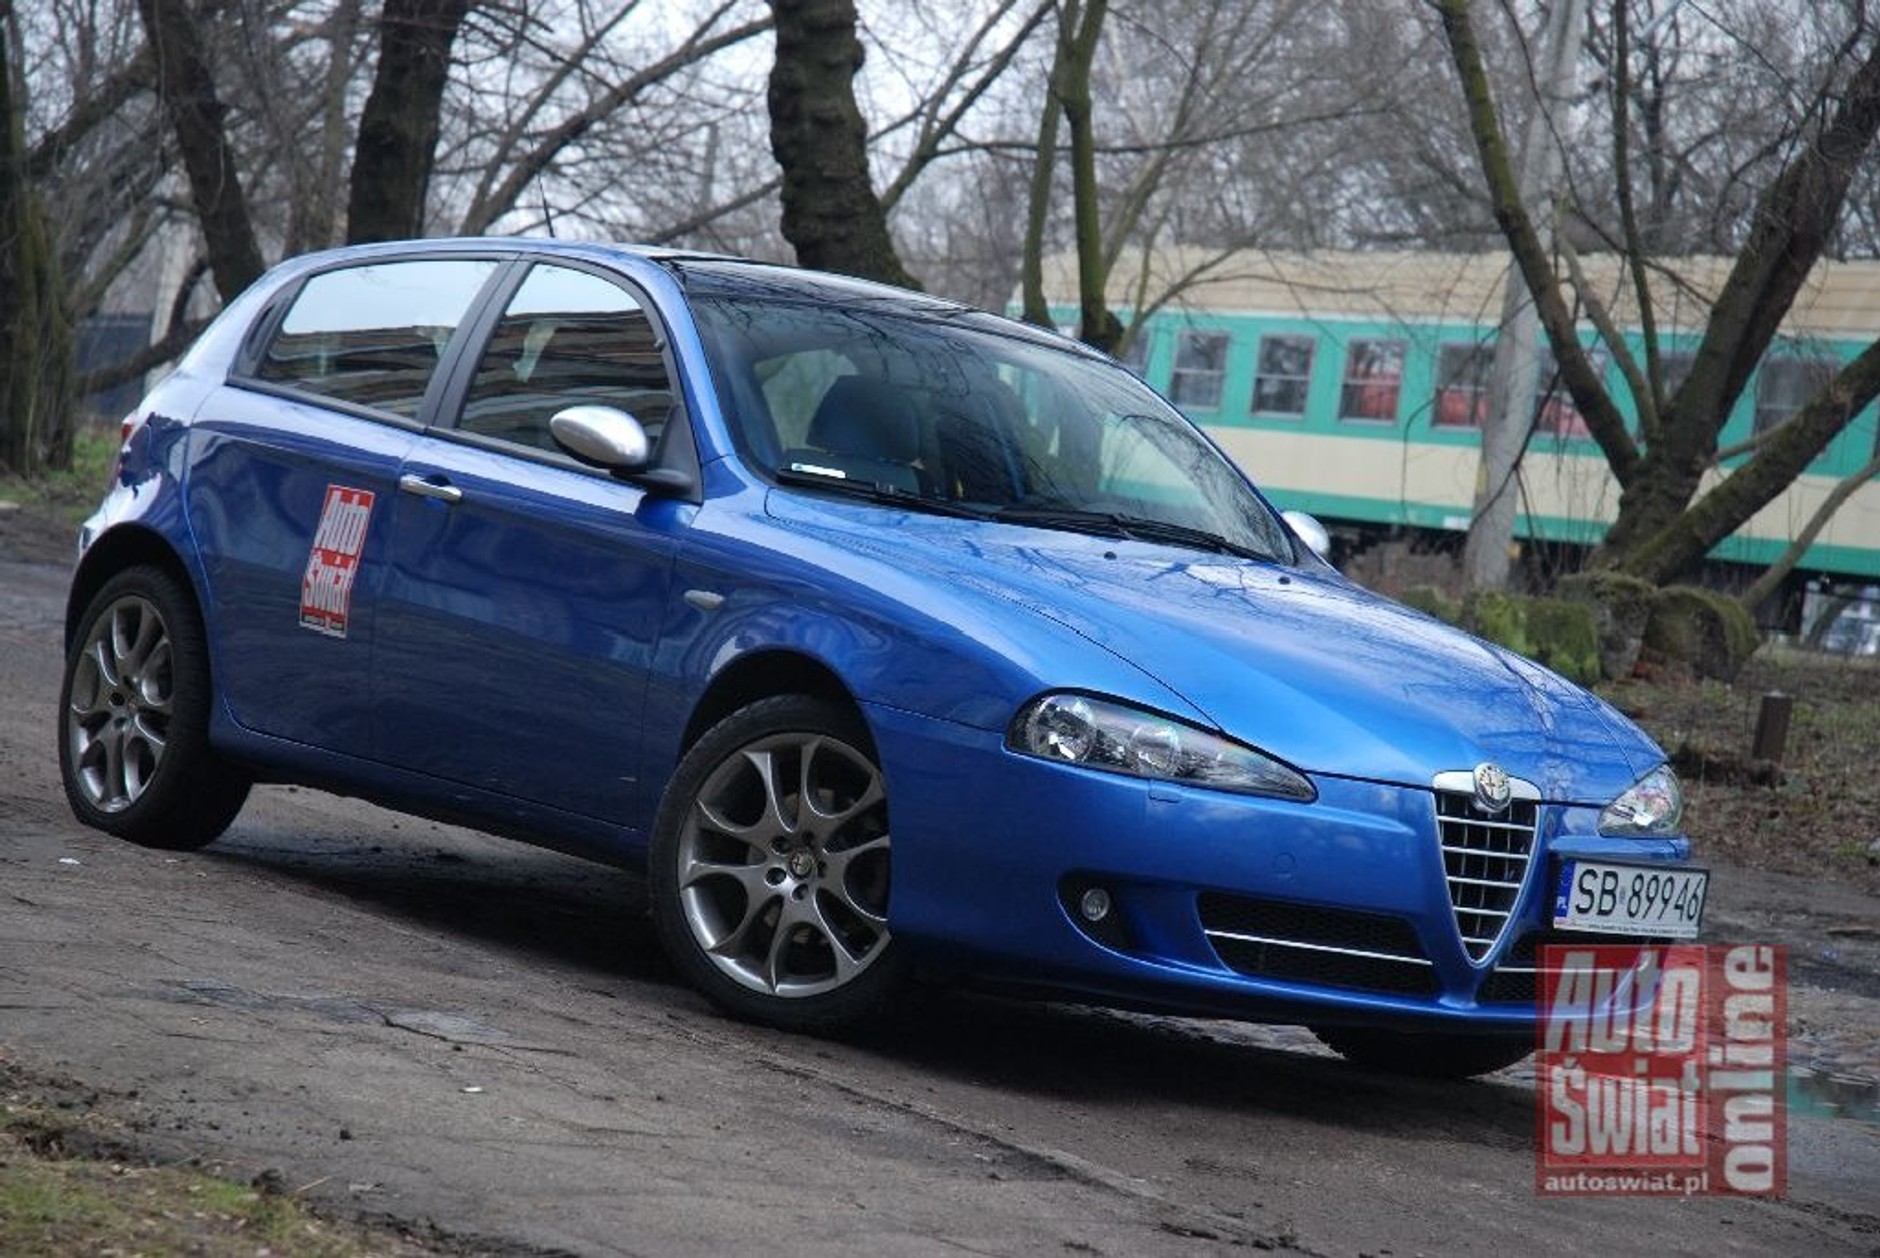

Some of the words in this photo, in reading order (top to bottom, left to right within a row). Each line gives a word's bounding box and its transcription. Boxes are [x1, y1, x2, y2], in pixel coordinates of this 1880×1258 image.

[314, 490, 369, 556] Auto
[1556, 896, 1568, 909] PL
[1575, 868, 1619, 916] SB
[1627, 872, 1704, 922] 89946
